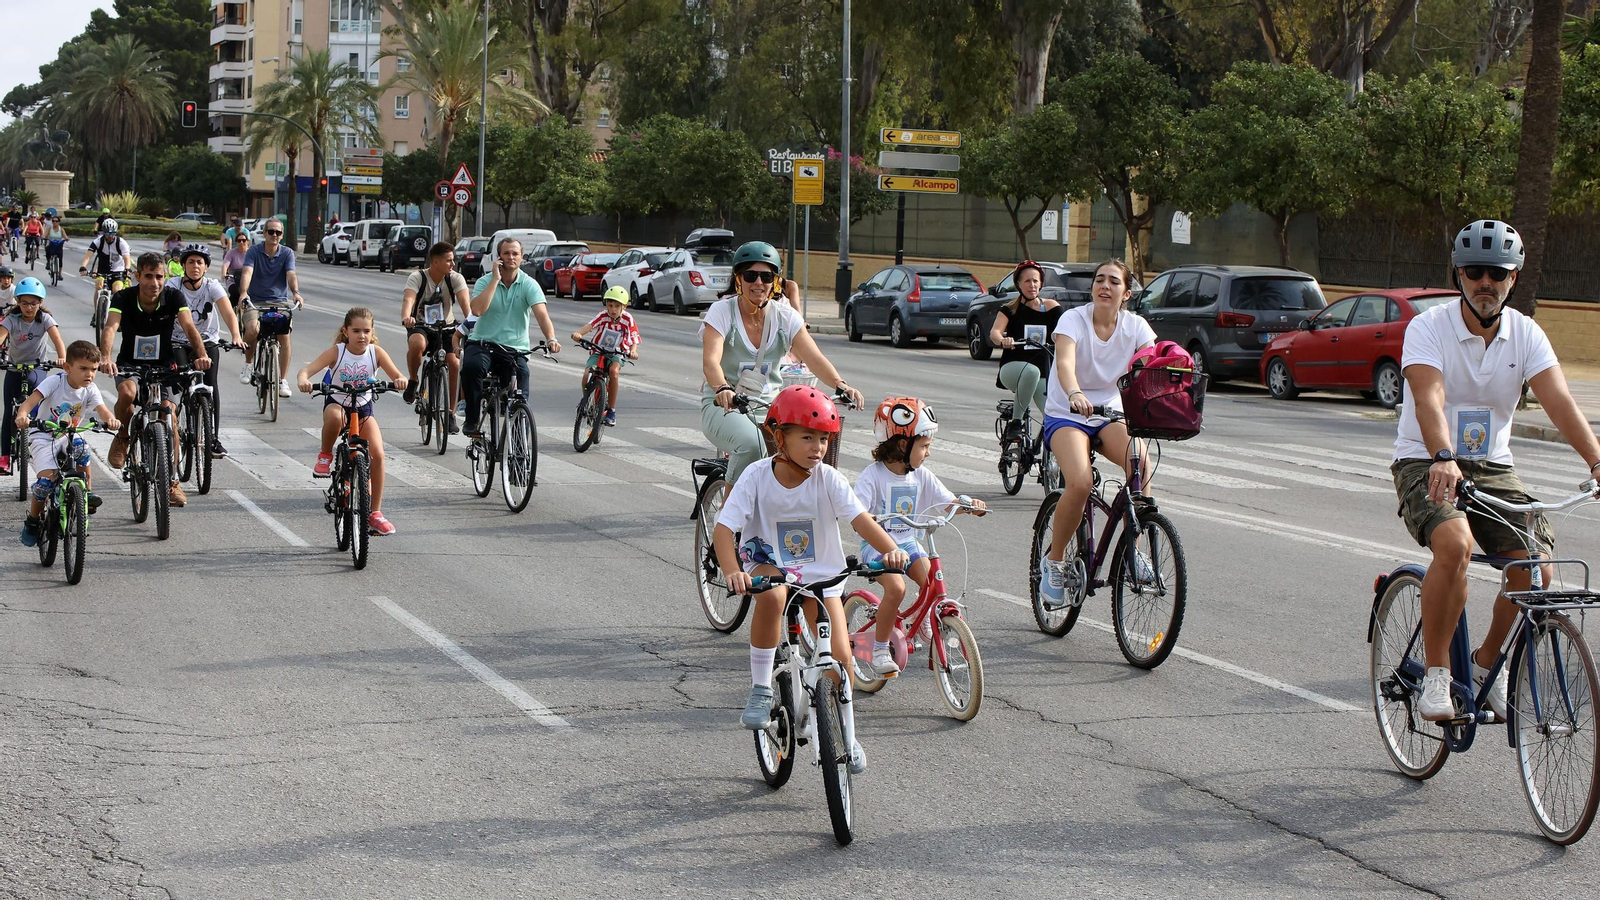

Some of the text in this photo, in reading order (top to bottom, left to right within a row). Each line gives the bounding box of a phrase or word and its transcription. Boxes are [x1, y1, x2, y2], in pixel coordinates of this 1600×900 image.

[768, 148, 825, 160] Restaurante
[771, 160, 781, 173] El
[912, 179, 956, 190] Alcampo
[456, 193, 467, 201] 30
